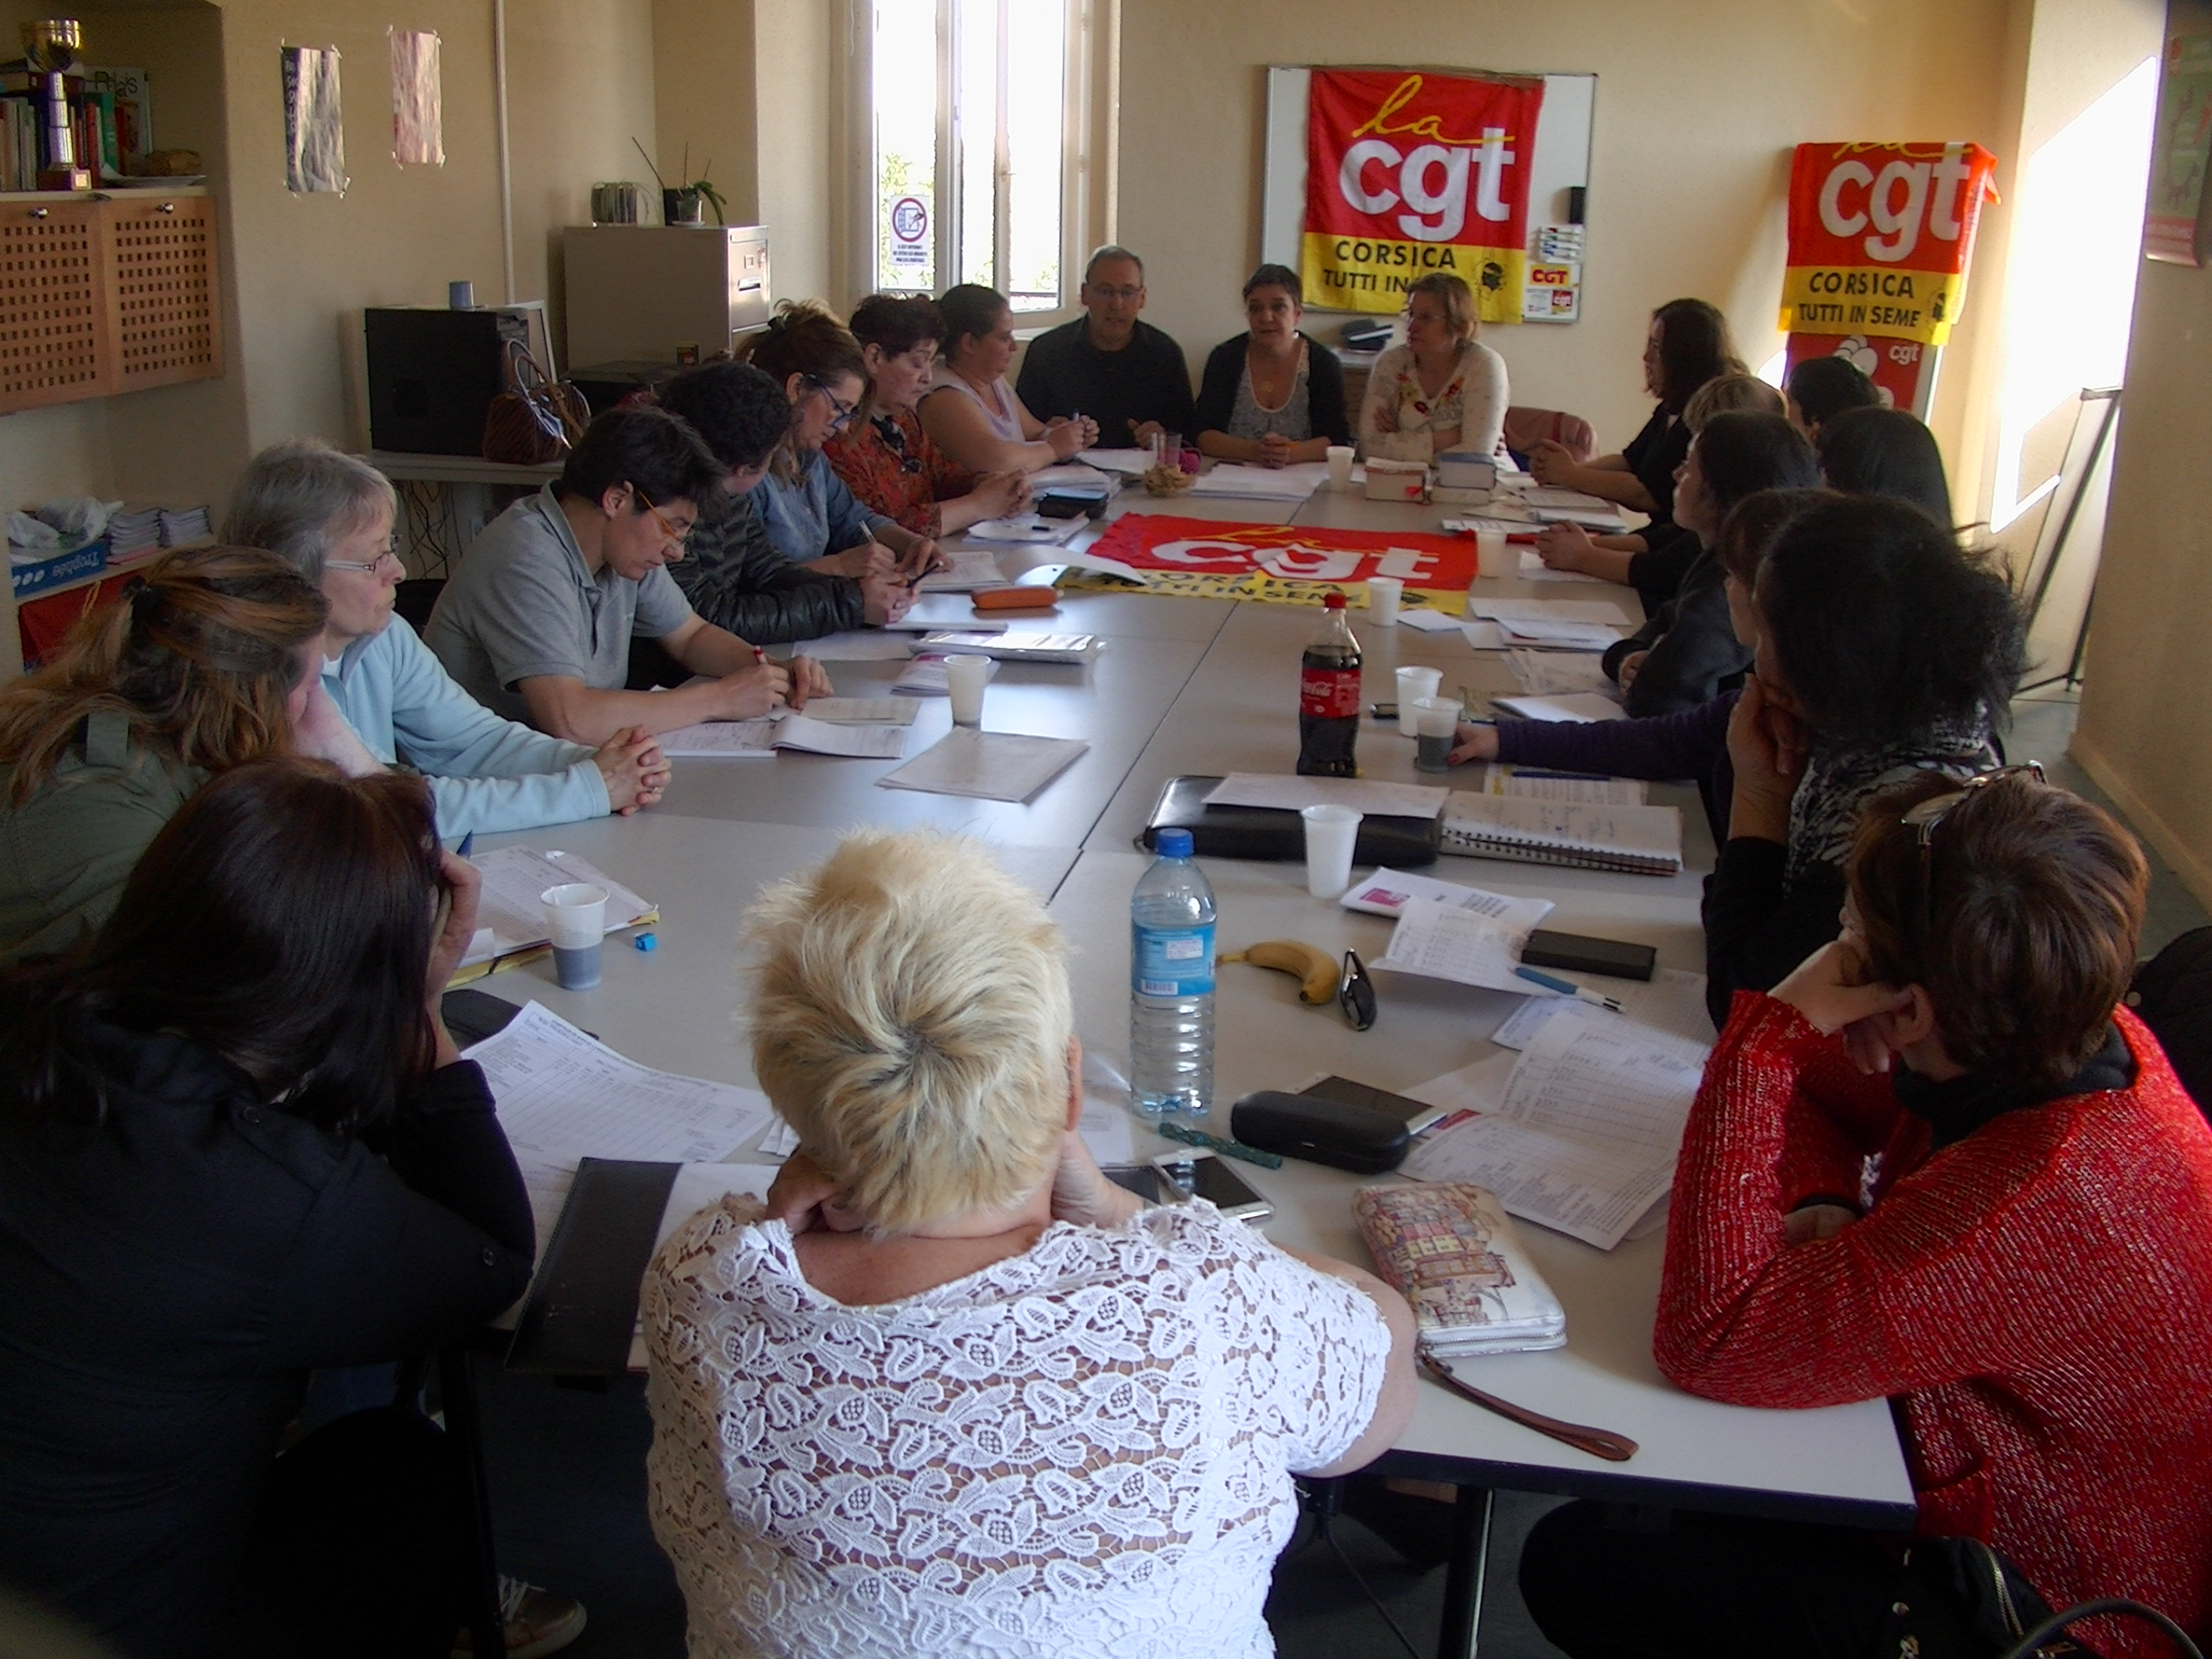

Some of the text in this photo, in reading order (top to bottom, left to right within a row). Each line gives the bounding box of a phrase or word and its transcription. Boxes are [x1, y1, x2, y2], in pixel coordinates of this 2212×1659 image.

[1353, 75, 1515, 145] la
[1339, 127, 1515, 241] cgt
[1819, 141, 1970, 262] cgt
[1335, 240, 1456, 269] CORSICA
[1324, 269, 1409, 293] TUTTI IN
[1532, 269, 1569, 284] CGT
[1809, 272, 1914, 298] CORSICA
[1799, 303, 1921, 327] TUTTI IN SEME
[1888, 343, 1919, 365] cgt
[1151, 540, 1439, 580] cgt
[1139, 572, 1344, 591] ORSICA
